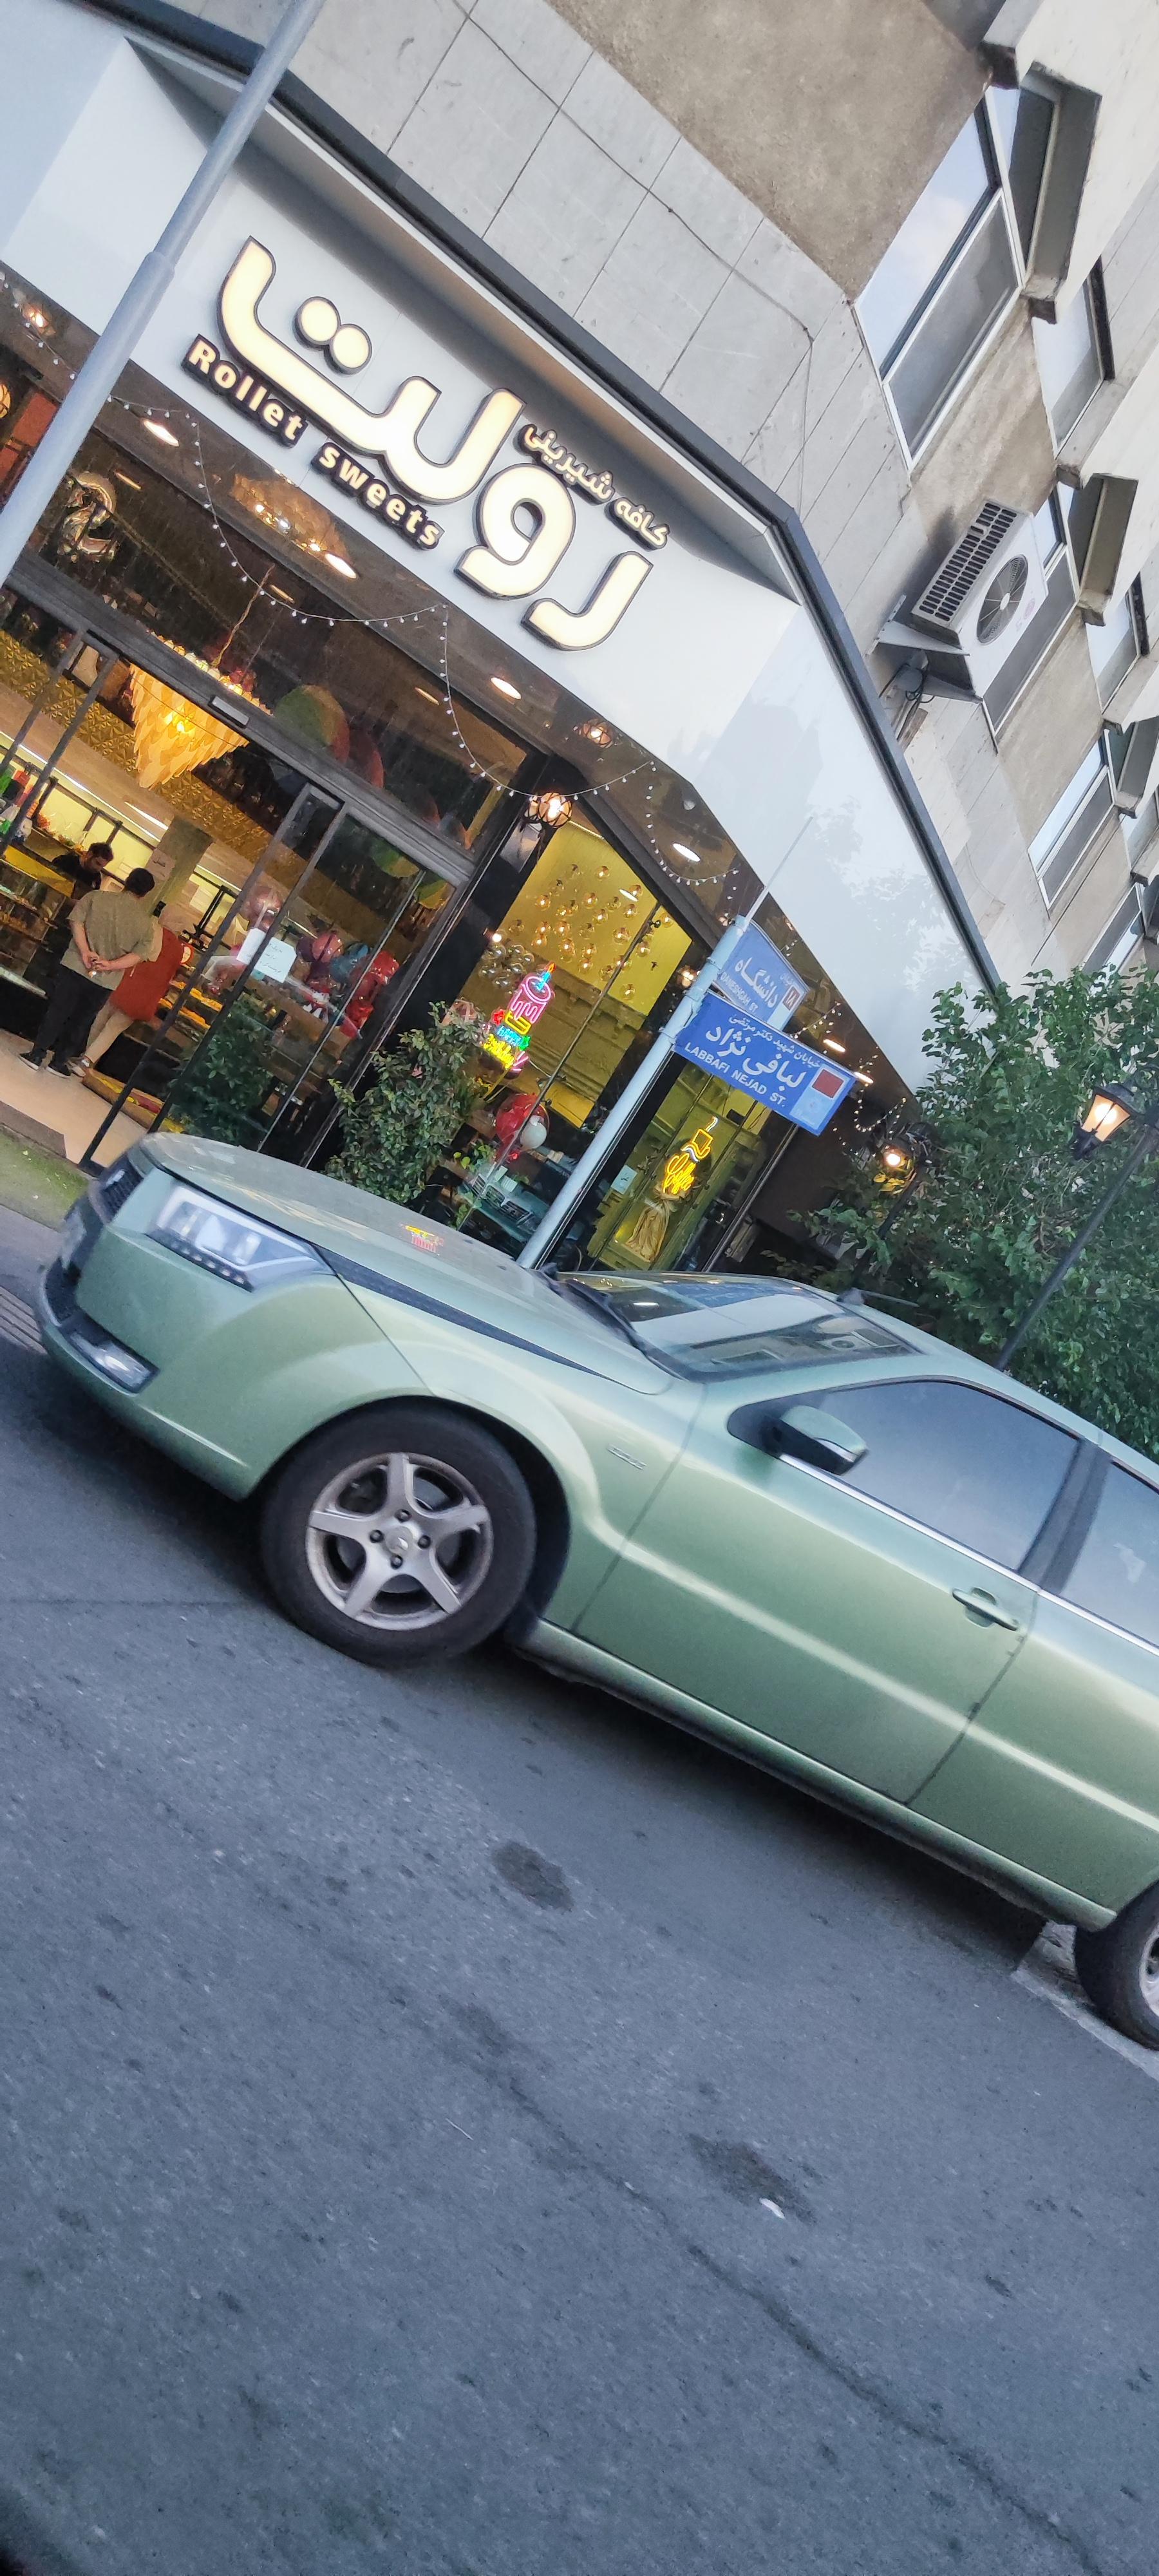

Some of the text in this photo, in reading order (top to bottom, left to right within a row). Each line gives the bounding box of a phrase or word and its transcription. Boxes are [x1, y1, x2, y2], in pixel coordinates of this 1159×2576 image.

[183, 336, 444, 550] Rollet sweets
[219, 236, 653, 650] رولت
[520, 424, 670, 549] کافه شیرینی
[735, 957, 779, 1009] دانشگاه
[706, 1026, 807, 1092] لبافی نژاد
[728, 1015, 822, 1068] خیابان شهید دکتر مرتضی
[684, 1042, 786, 1108] LABBAFI NEJAD ST.
